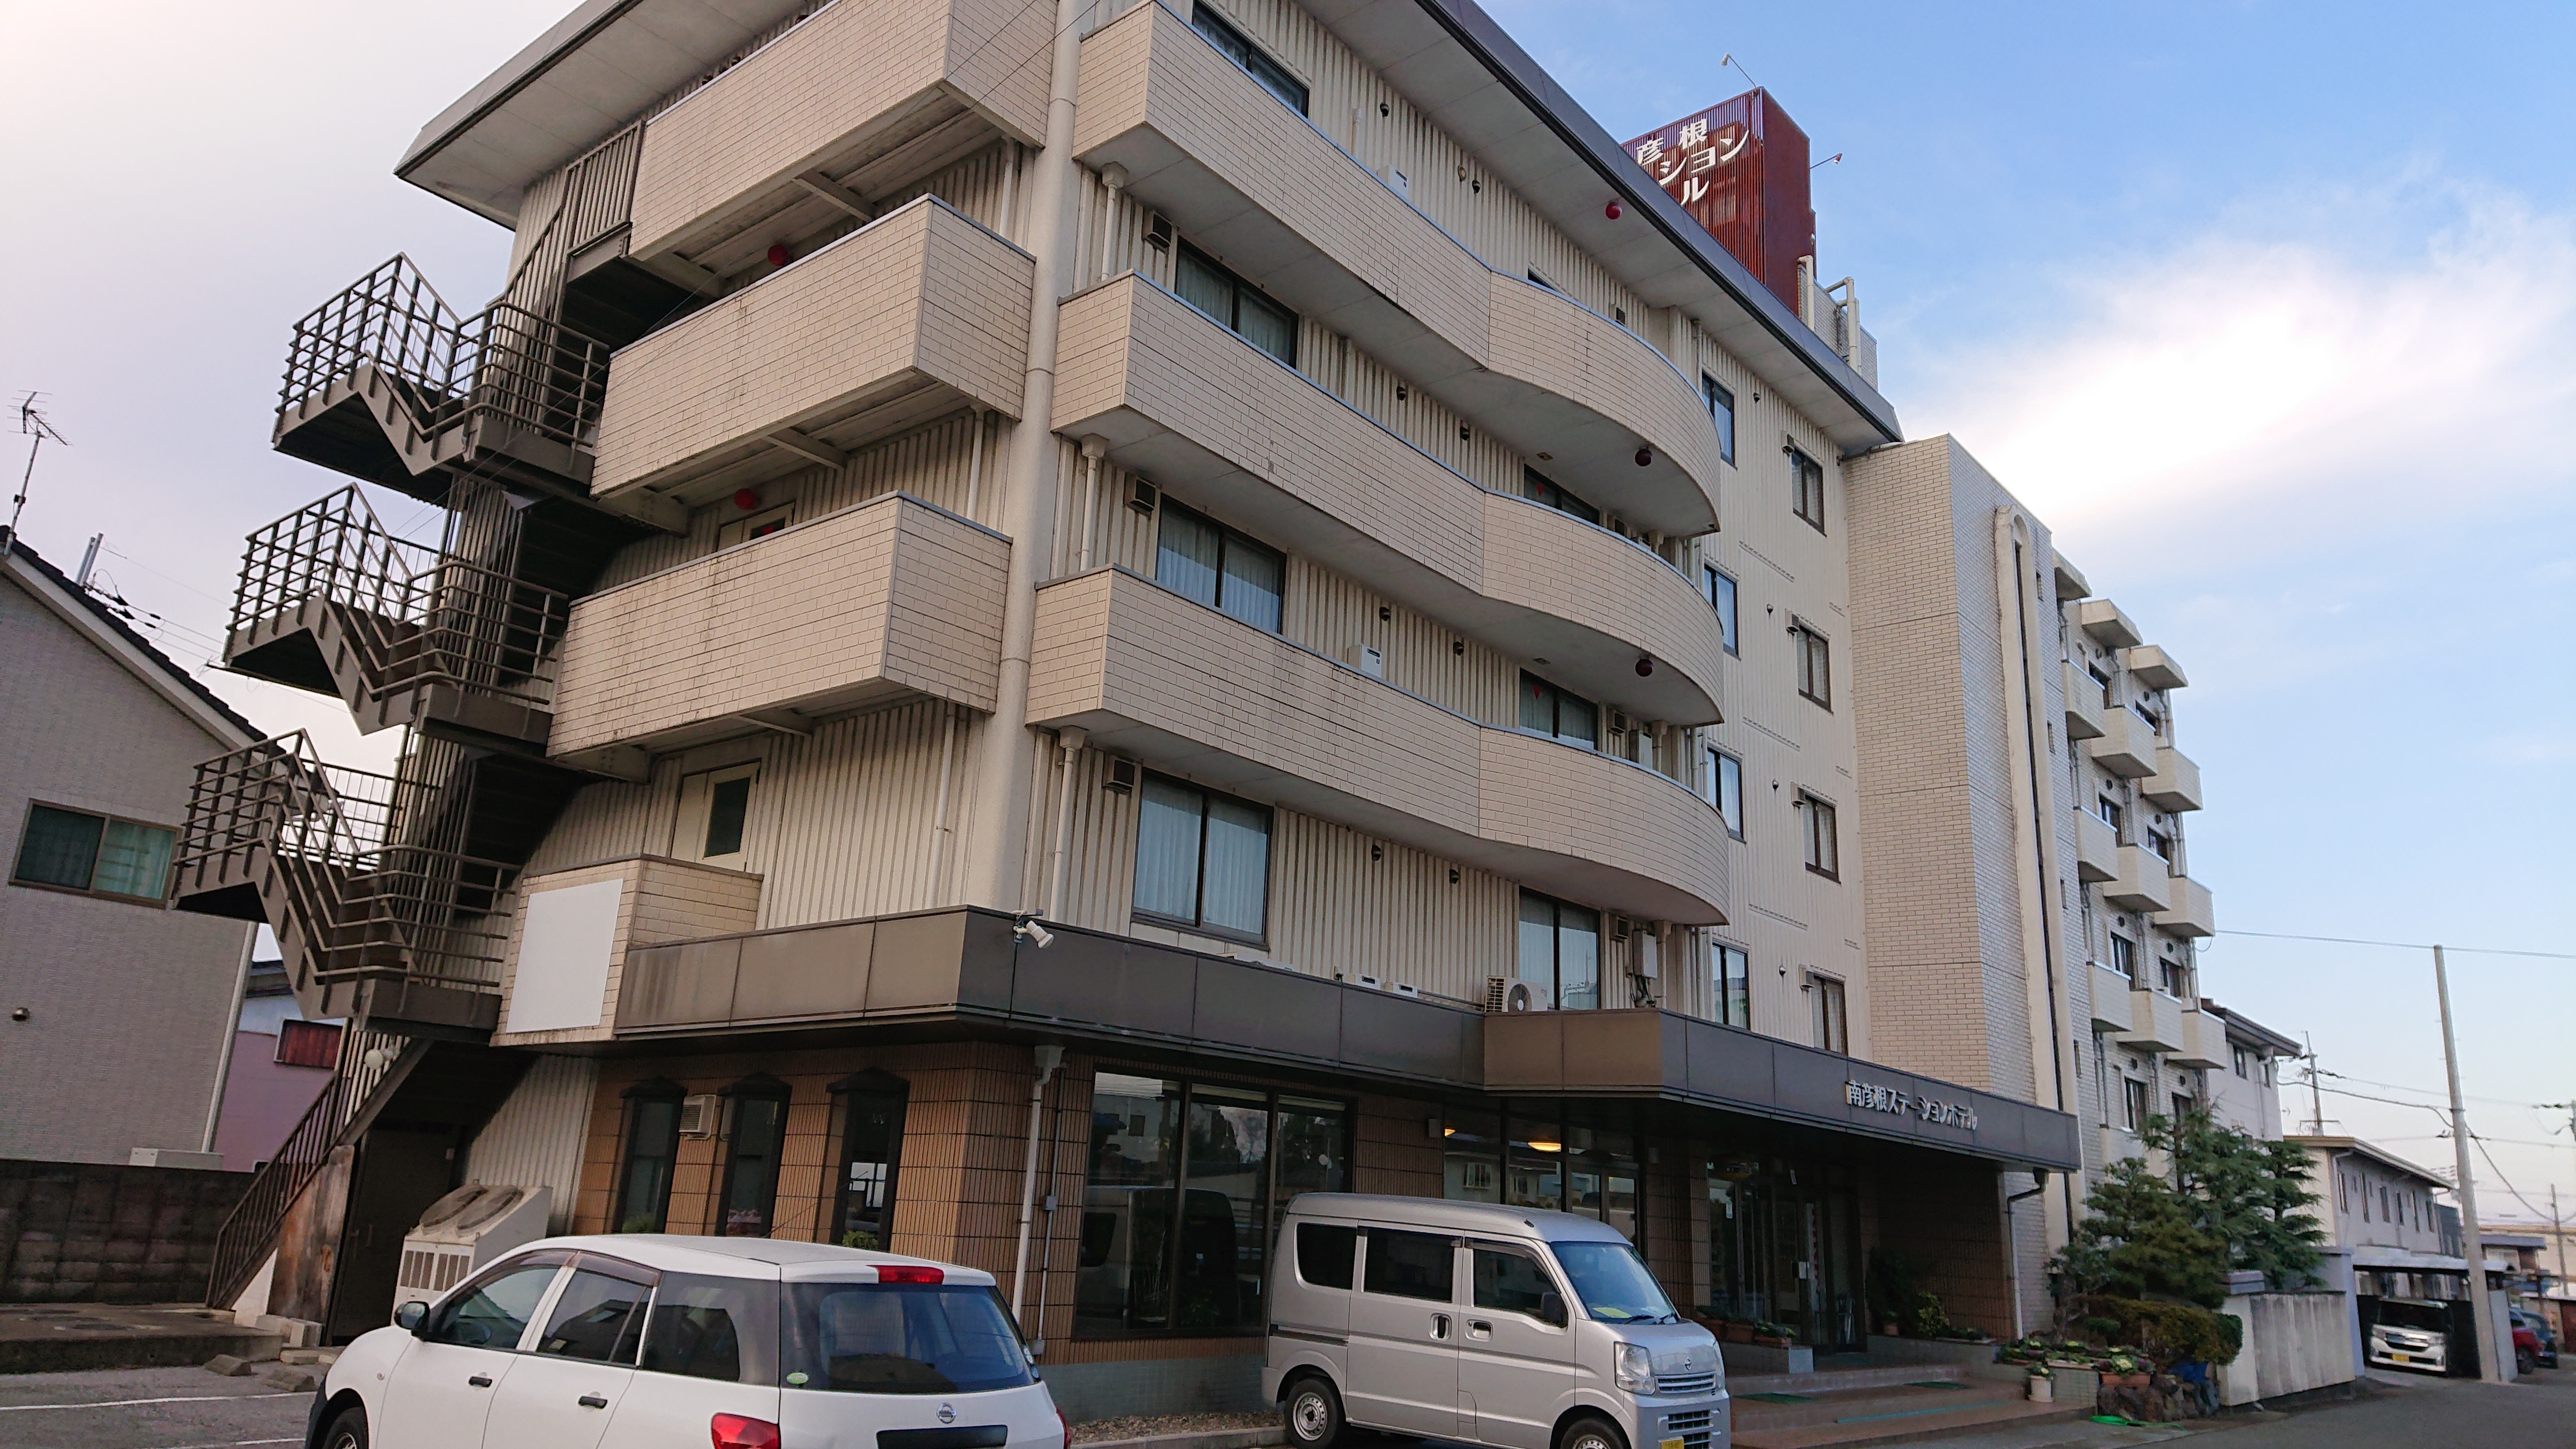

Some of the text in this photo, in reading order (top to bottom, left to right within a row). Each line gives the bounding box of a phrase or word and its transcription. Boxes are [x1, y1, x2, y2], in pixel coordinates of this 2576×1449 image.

[1680, 176, 1709, 206] ル
[1846, 1079, 1978, 1130] 南彦根ステーションホテル
